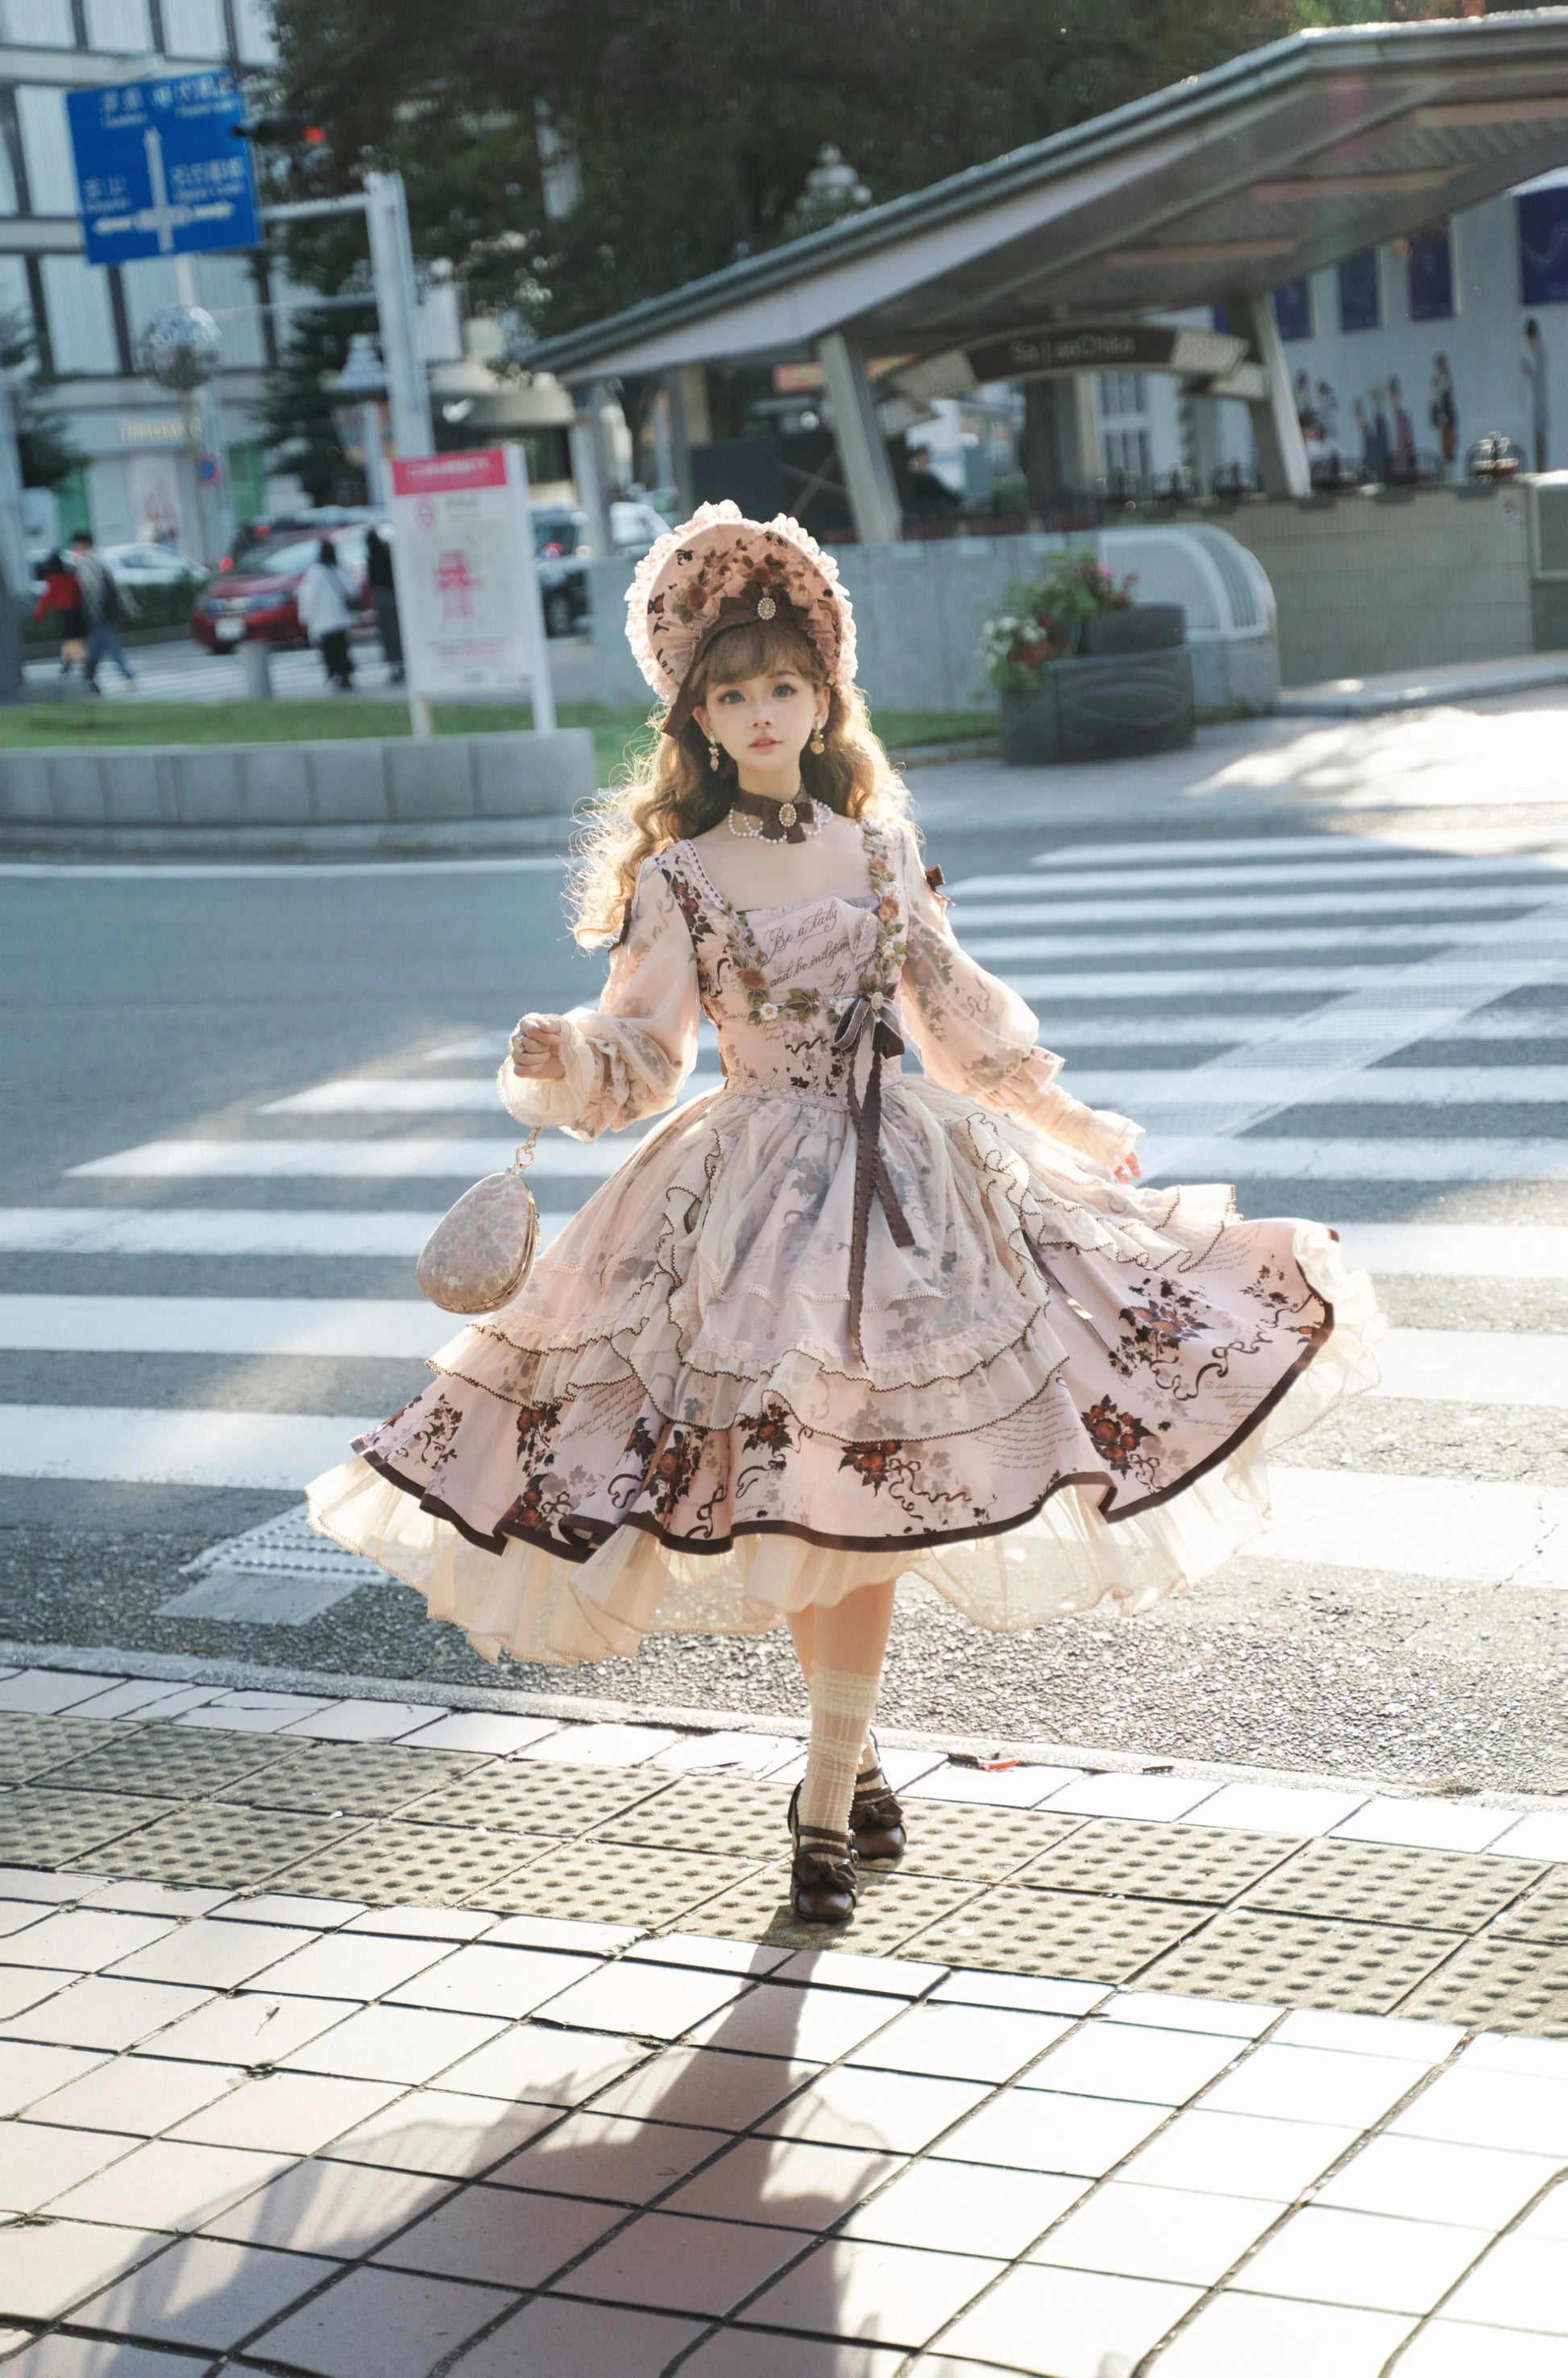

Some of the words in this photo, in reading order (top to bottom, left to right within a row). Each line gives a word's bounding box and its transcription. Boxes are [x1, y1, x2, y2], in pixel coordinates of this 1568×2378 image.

[796, 927, 807, 940] a
[800, 900, 837, 948] lady
[760, 924, 793, 967] Be
[770, 961, 794, 987] and
[794, 957, 808, 977] be
[828, 966, 851, 996] by
